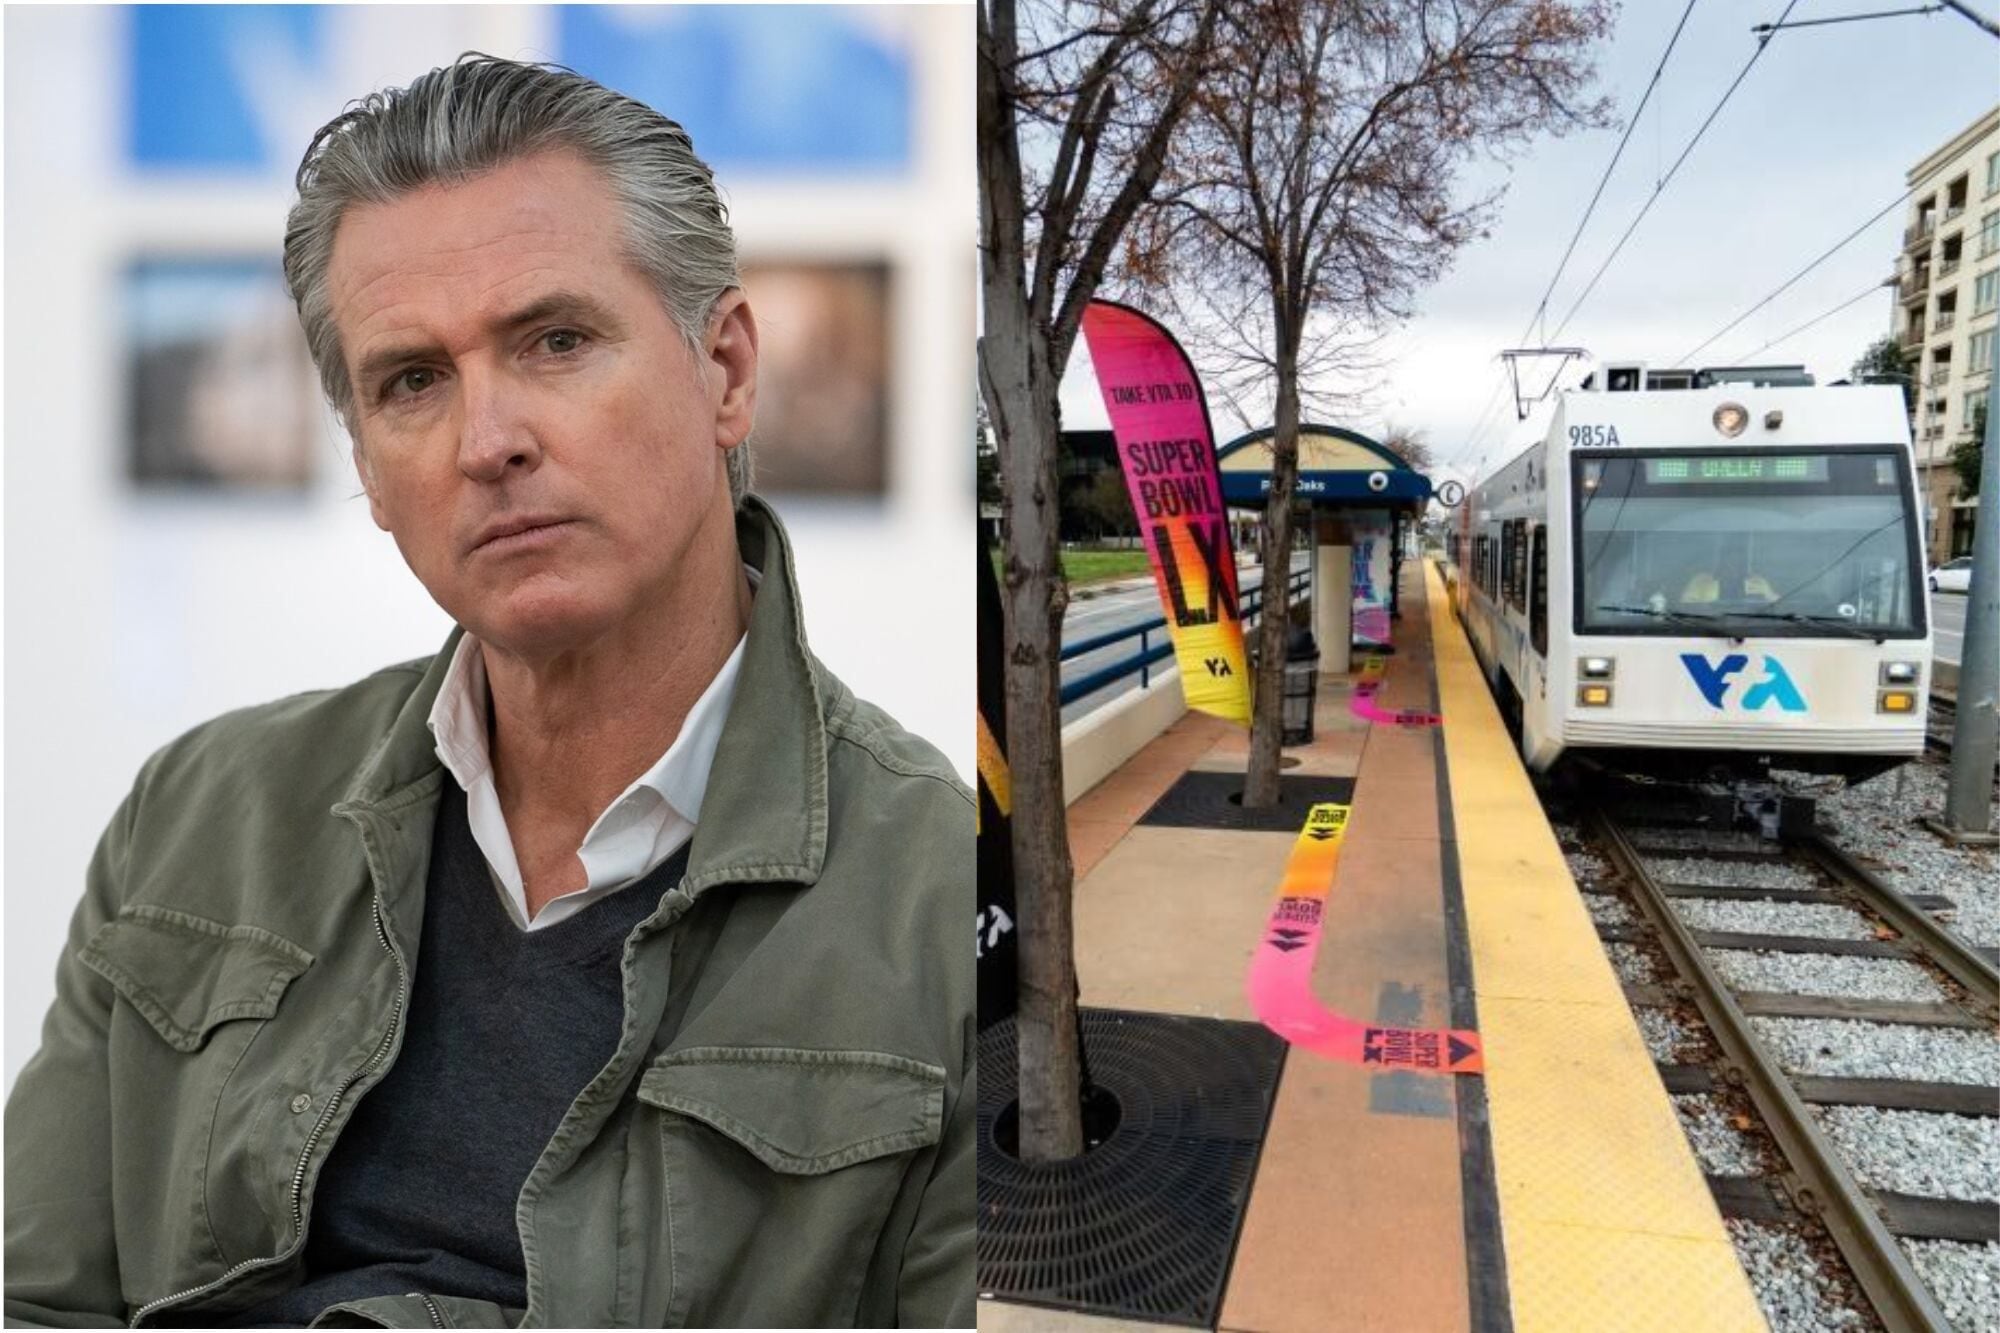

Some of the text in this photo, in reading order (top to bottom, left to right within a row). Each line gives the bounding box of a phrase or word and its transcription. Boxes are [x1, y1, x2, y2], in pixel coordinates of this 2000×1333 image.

[1111, 382, 1192, 404] TAKE VTA TO
[1569, 425, 1620, 446] 985A
[1128, 439, 1207, 476] SUPER
[1139, 475, 1220, 518] BOWL
[1152, 523, 1238, 627] LX
[1364, 1029, 1382, 1063] LX
[1385, 1029, 1412, 1065] BOWL
[1415, 1031, 1439, 1068] SUPER
